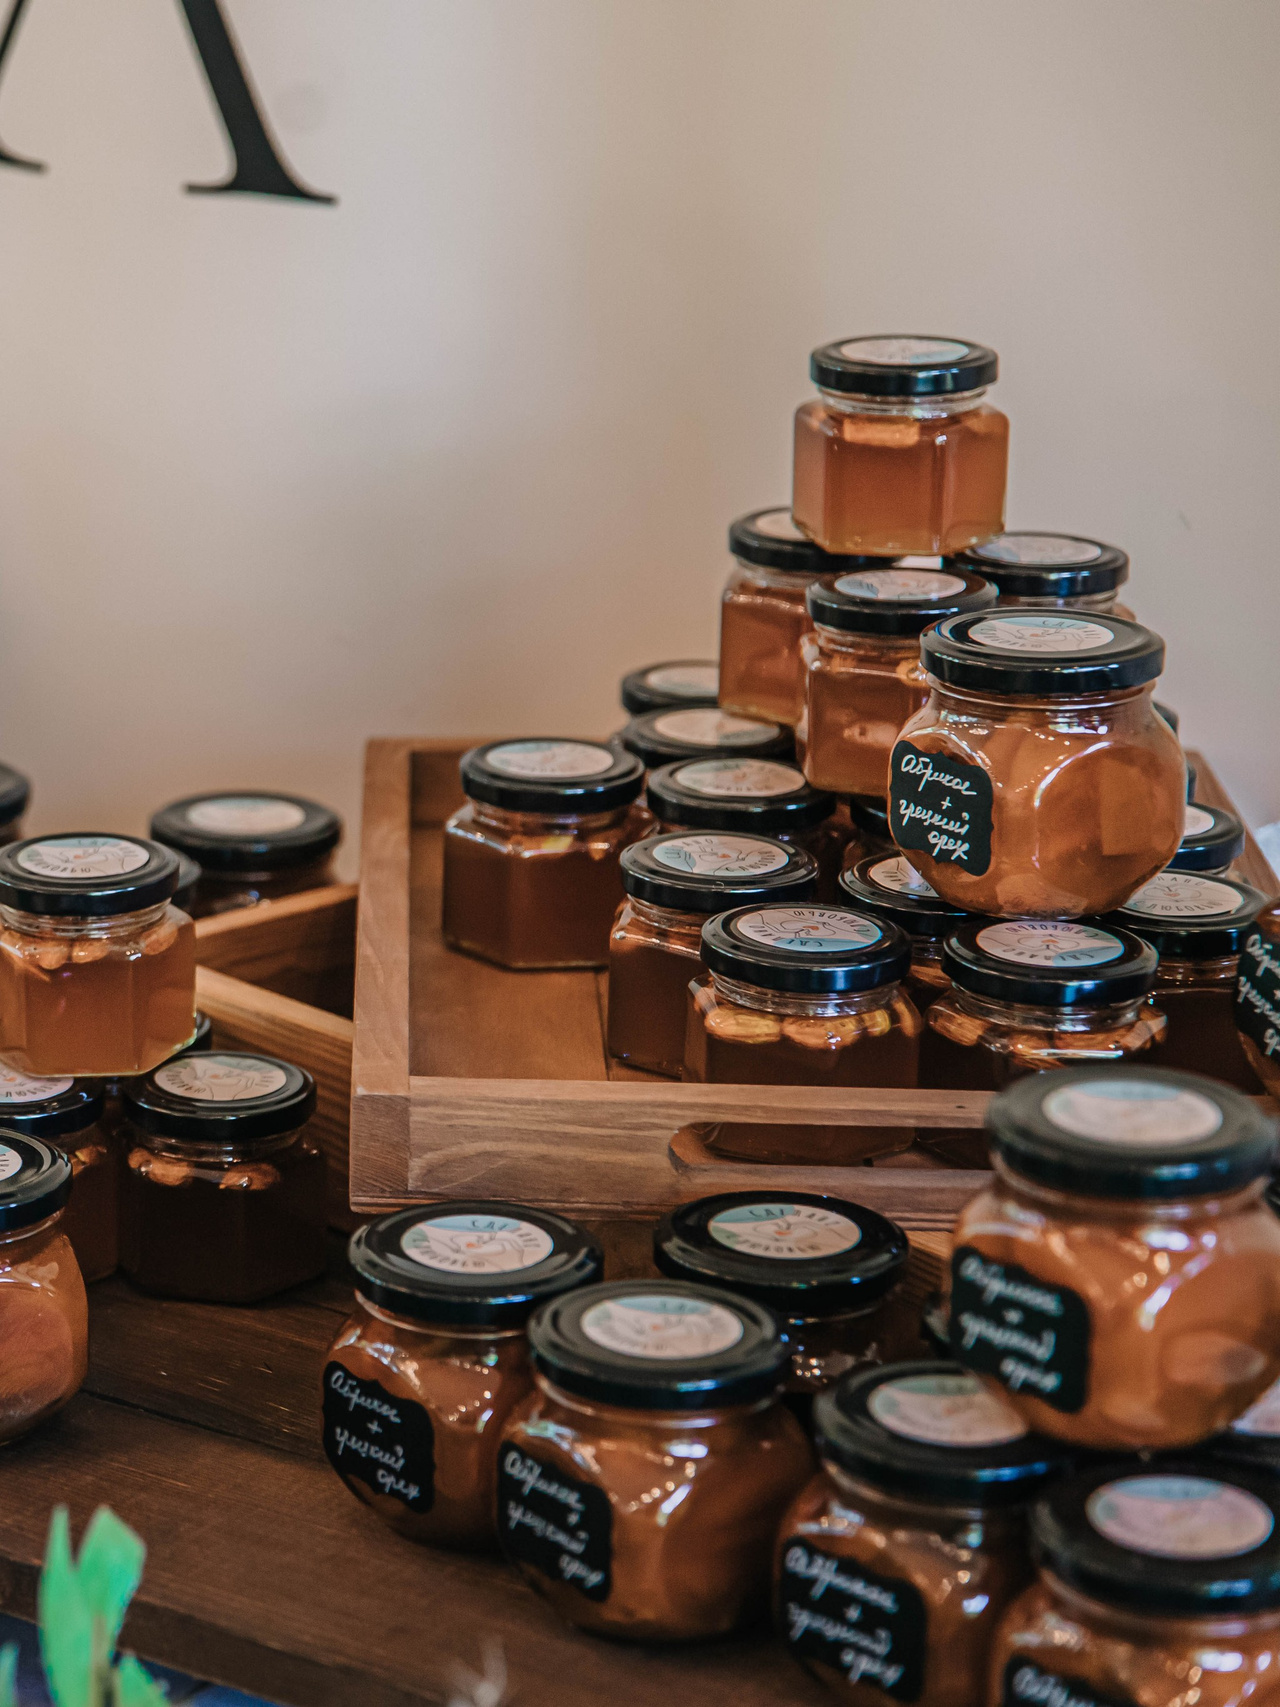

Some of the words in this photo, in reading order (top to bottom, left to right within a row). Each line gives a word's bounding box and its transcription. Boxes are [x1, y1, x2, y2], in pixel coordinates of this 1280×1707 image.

[901, 754, 977, 796] Абрикос
[899, 799, 970, 836] грецкий
[928, 831, 970, 861] орех
